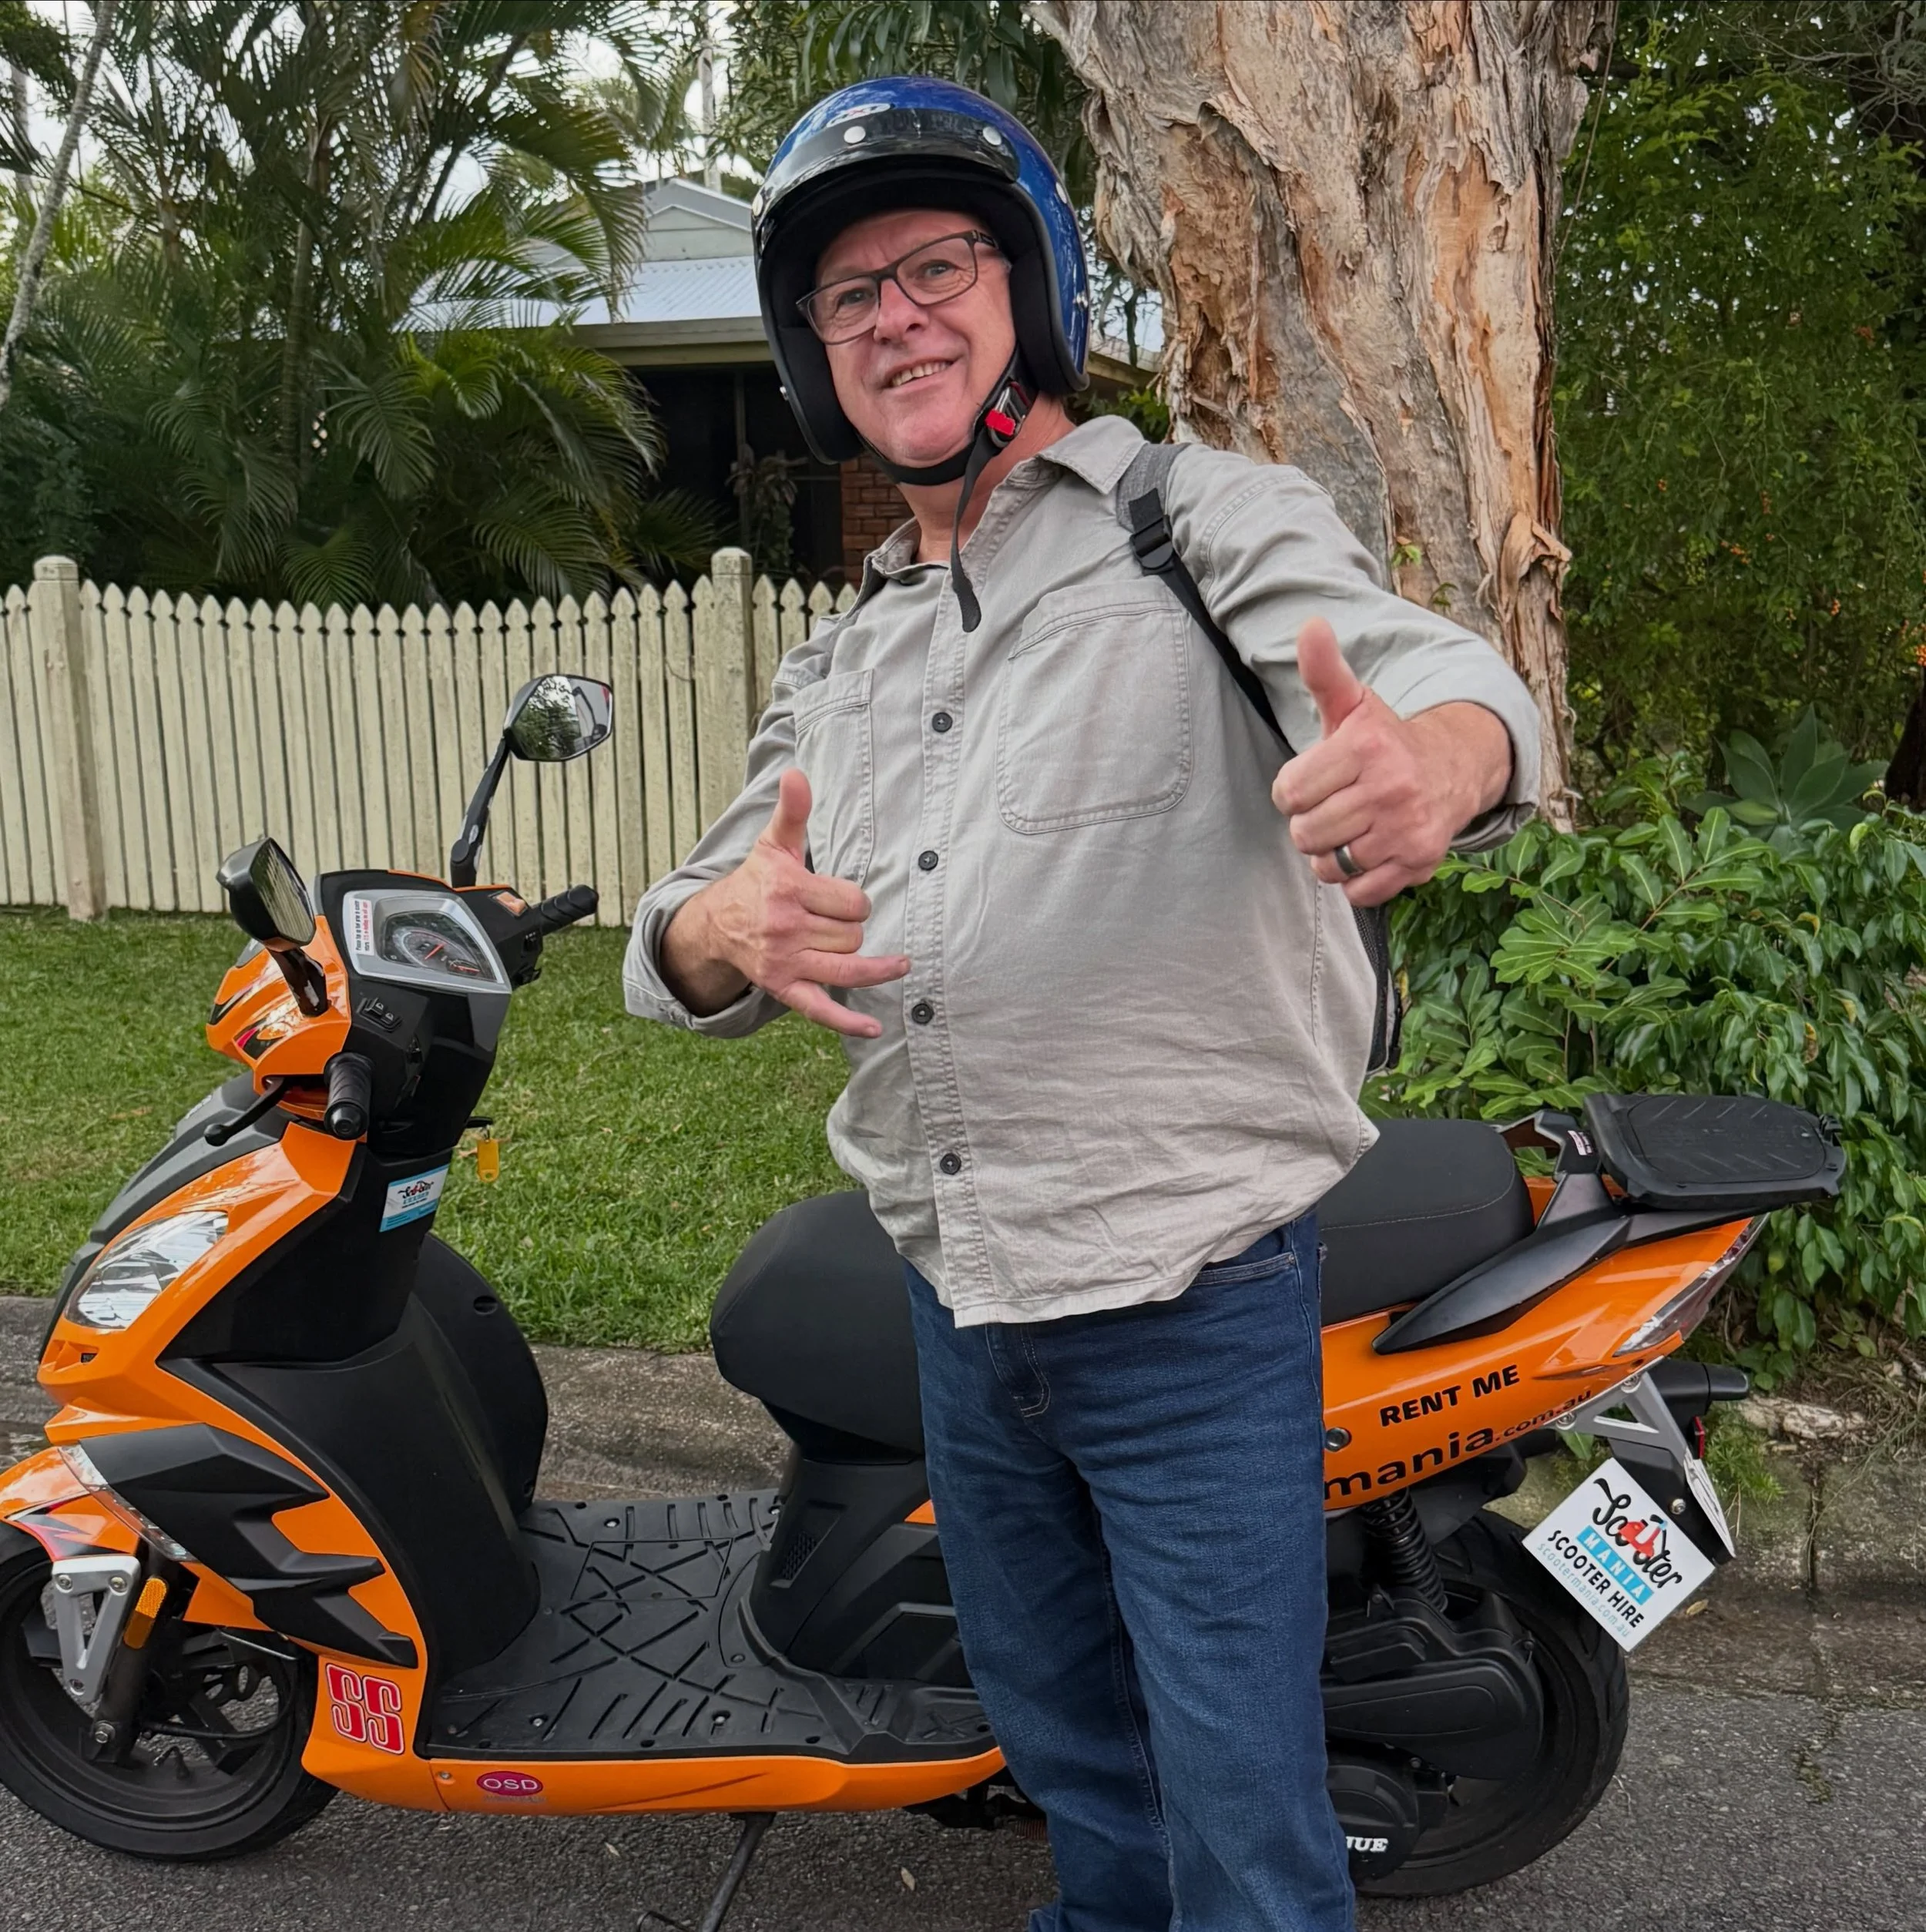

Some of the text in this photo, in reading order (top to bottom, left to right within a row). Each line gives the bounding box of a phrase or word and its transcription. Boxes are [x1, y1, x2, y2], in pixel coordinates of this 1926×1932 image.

[1380, 1364, 1520, 1427] RENT ME
[1538, 1543, 1629, 1637] scootermania.com.au
[1547, 1530, 1644, 1628] SCOOTER HIRE
[1584, 1533, 1647, 1599] MANIA
[326, 1662, 404, 1755] SS
[483, 1778, 539, 1791] OSD
